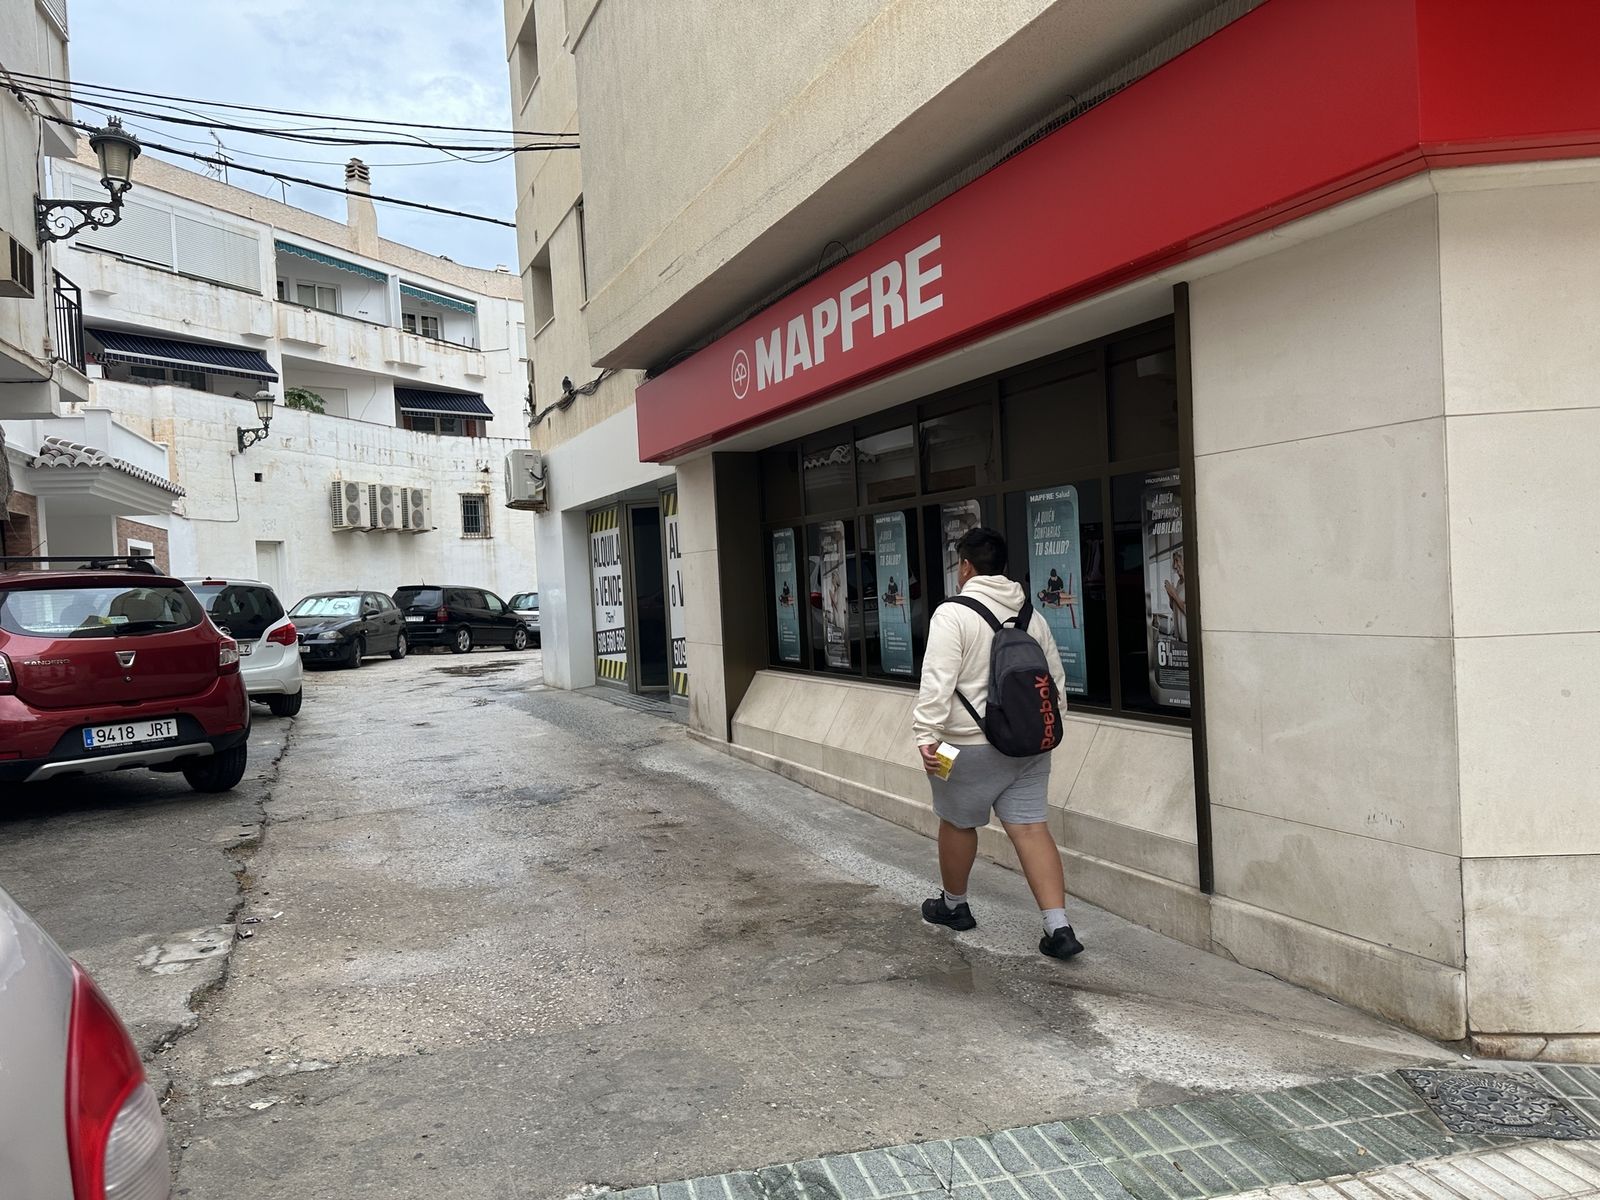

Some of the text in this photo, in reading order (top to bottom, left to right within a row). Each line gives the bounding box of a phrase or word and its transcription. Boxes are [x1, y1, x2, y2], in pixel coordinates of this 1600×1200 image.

[755, 234, 943, 392] MAPFRE
[1030, 490, 1070, 502] MAPFRE Salud
[593, 533, 621, 568] ALQUILA
[669, 522, 681, 559] AL
[1035, 540, 1070, 556] TU SALUD?
[598, 575, 622, 606] VENDE
[673, 640, 687, 665] 609
[96, 725, 136, 743] 9418
[146, 721, 173, 737] JRT
